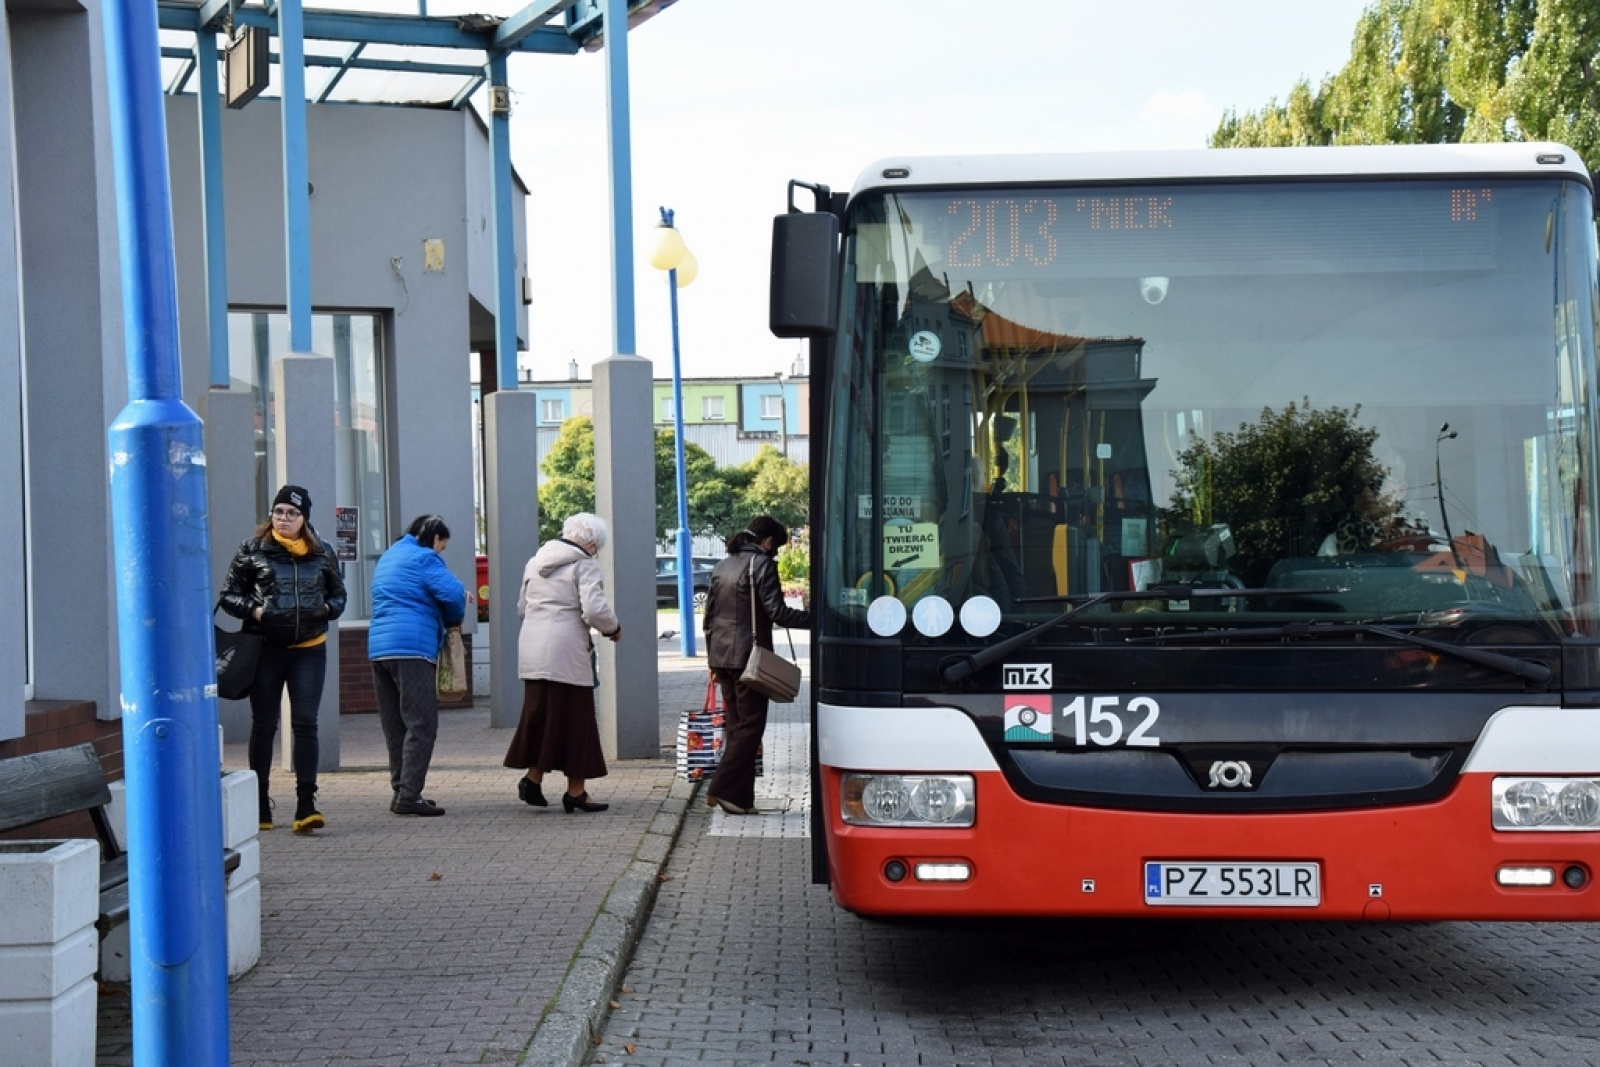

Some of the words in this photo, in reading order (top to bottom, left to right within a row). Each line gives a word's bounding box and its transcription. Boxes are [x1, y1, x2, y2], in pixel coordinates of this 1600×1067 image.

[948, 199, 1057, 266] 203
[866, 496, 897, 506] TKO
[882, 533, 934, 543] TWIERAĆ
[888, 545, 924, 553] DRZWI
[1062, 696, 1160, 746] 152
[1149, 885, 1160, 893] PL
[1166, 868, 1208, 896] PZ
[1220, 868, 1312, 896] 553LR
